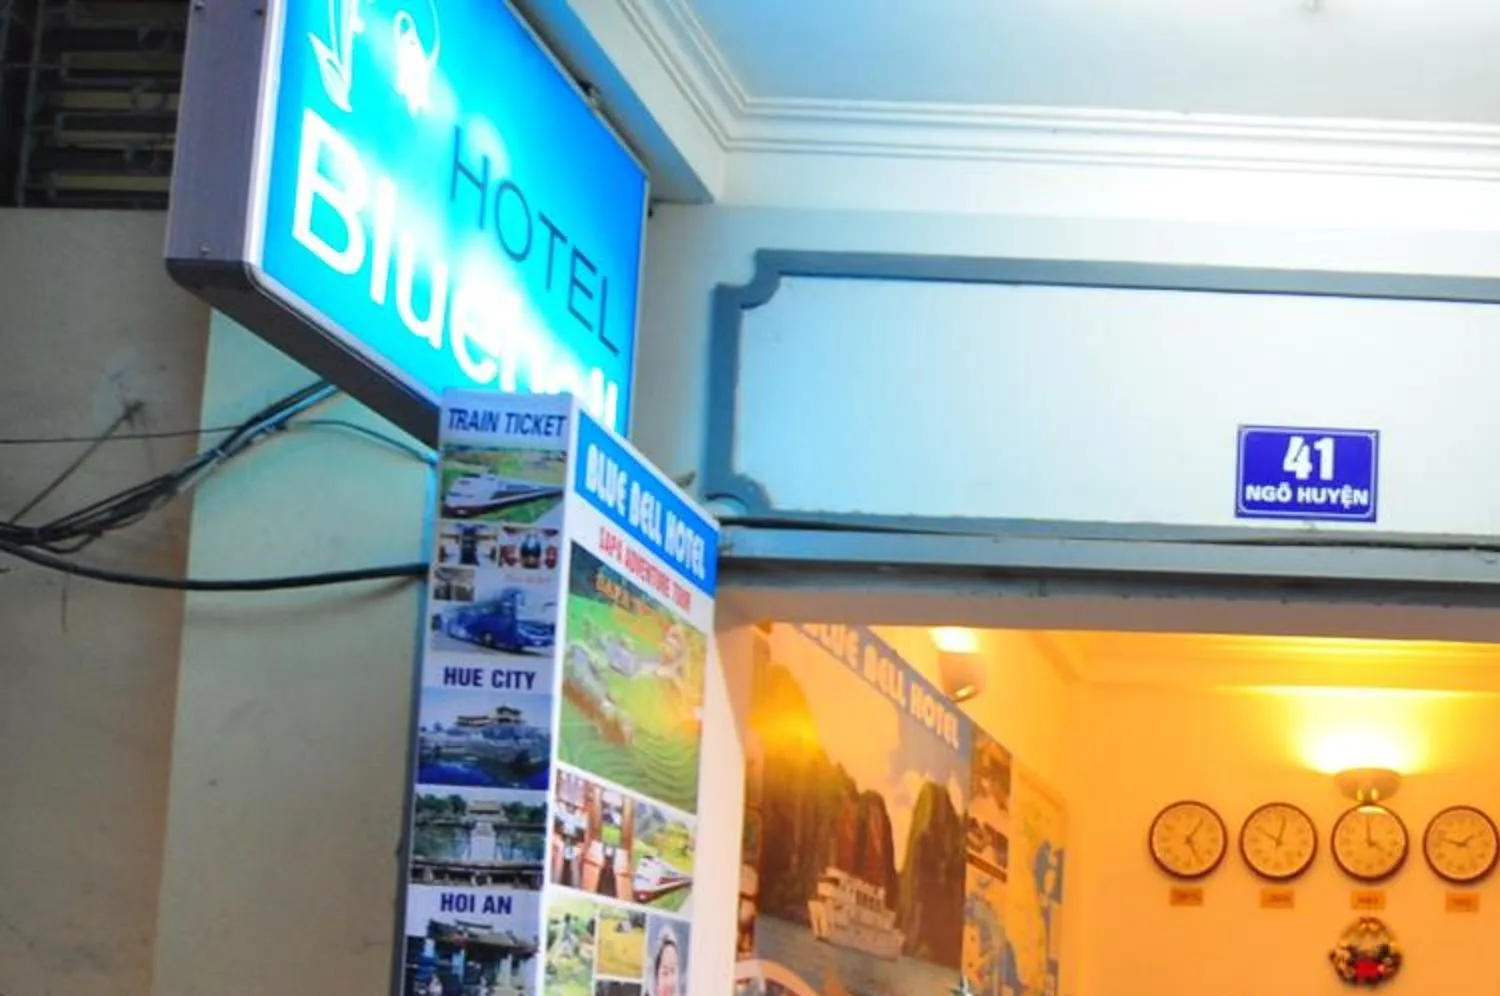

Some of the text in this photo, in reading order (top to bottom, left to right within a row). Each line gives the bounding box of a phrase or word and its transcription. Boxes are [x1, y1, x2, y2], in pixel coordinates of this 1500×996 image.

[451, 125, 619, 356] HOTEL
[448, 408, 567, 437] TRAIN TICKET
[1283, 436, 1335, 480] 41
[585, 443, 705, 581] BLUE BELL HOTEL
[1297, 484, 1369, 509] HUYỆN
[443, 666, 536, 690] HUE CITY
[864, 643, 906, 708] BELL
[910, 682, 960, 749] HOTEL
[440, 893, 512, 915] HOI AN
